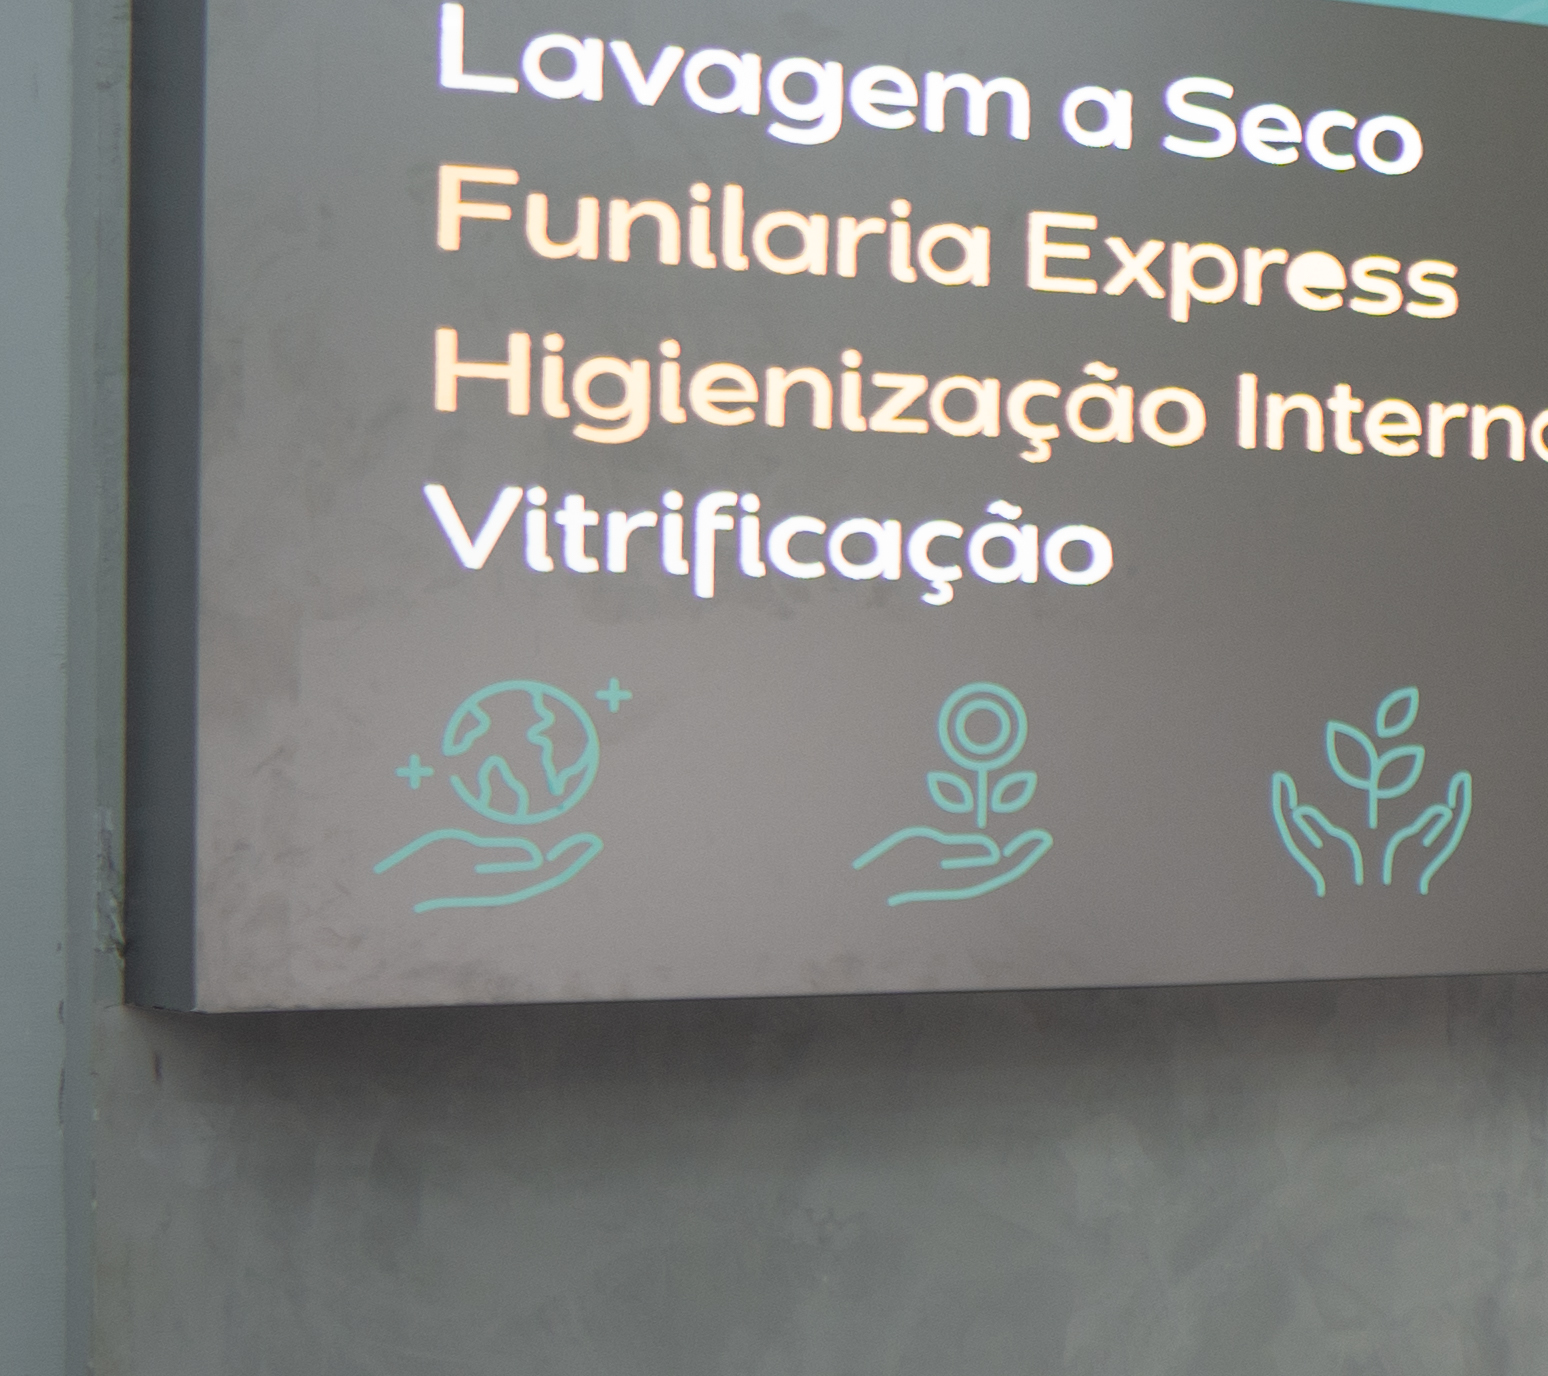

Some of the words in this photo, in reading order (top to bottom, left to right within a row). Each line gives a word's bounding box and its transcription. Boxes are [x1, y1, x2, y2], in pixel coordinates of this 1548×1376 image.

[436, 1, 1032, 146] Lavagem
[1059, 85, 1134, 150] a
[1160, 76, 1424, 175] Seco
[434, 163, 991, 288] Funilaria
[1025, 210, 1460, 323] Express
[433, 327, 1207, 464] Higienização
[421, 483, 1114, 606] Vitrificação
